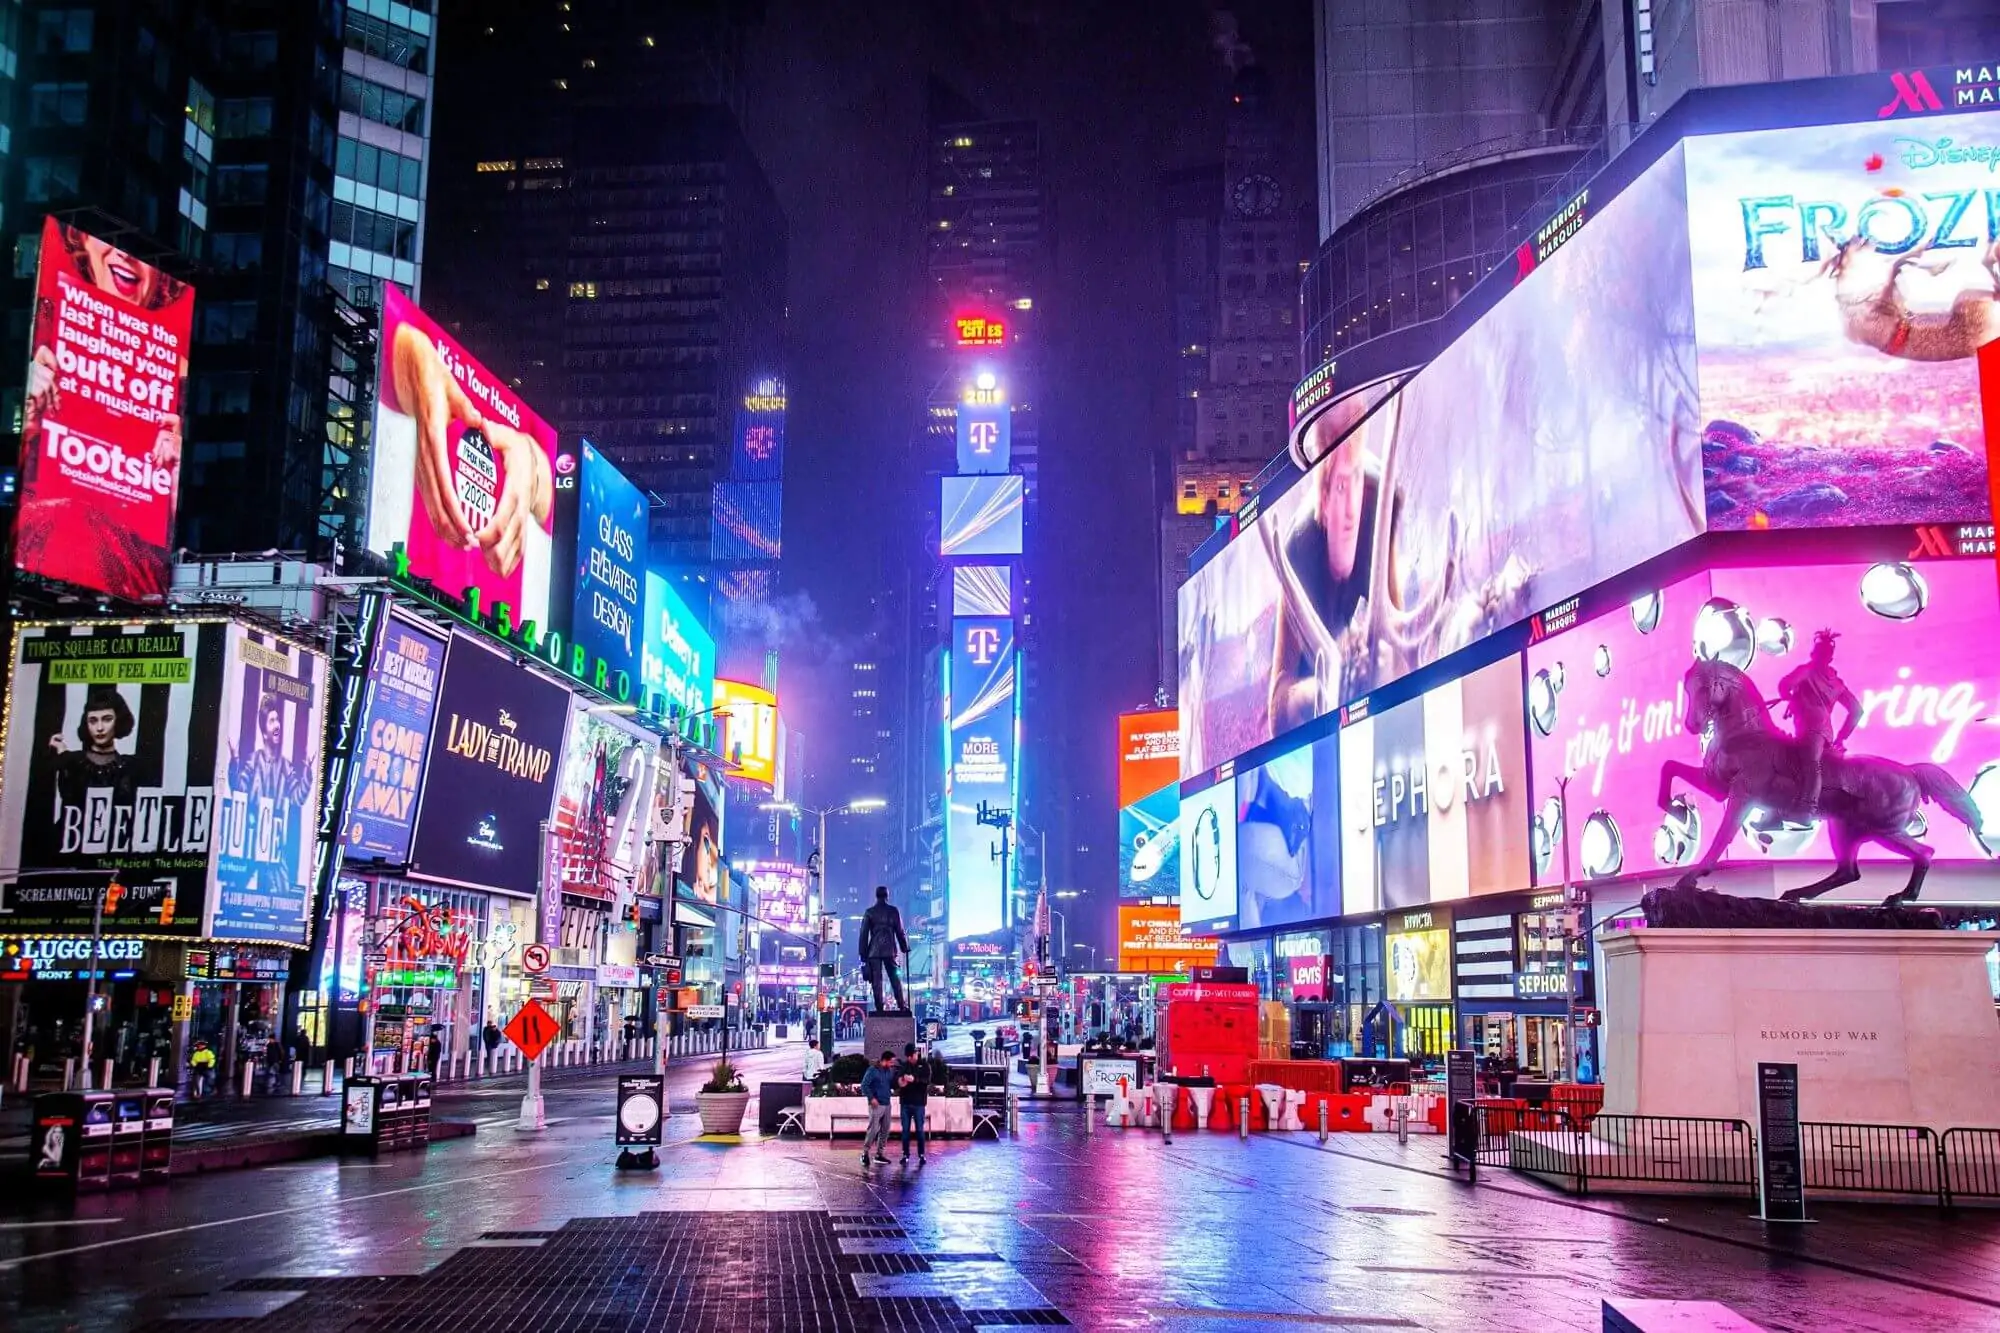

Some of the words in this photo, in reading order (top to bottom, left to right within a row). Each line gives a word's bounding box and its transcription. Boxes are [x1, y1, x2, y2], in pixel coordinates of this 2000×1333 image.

[1956, 65, 2000, 84] MA
[1958, 86, 2000, 105] MA
[1538, 189, 1589, 245] MARRIOTT
[1539, 213, 1583, 261] MARQUIS
[60, 299, 95, 330] last
[100, 319, 141, 349] time
[145, 340, 176, 364] you
[118, 310, 149, 335] was
[152, 323, 178, 347] the
[58, 319, 134, 366] laughed
[136, 356, 175, 382] your
[56, 339, 126, 393] butt
[129, 378, 174, 412] off
[60, 377, 78, 394] at
[81, 385, 92, 399] a
[437, 339, 454, 371] It's
[454, 354, 465, 381] in
[466, 364, 491, 402] Your
[490, 386, 520, 429] Hands
[1296, 361, 1337, 402] MARRIOTT
[1297, 381, 1331, 417] MARQUIS
[41, 418, 172, 495] Tootsie
[465, 450, 478, 464] FOX
[478, 460, 494, 479] NEWS
[465, 481, 487, 512] 2020
[555, 477, 574, 489] LG
[599, 514, 633, 562] GLASS
[590, 547, 638, 605] ELEVATES
[200, 591, 244, 602] LAMAR
[1545, 597, 1580, 622] MARRIOTT
[464, 586, 562, 665] 1540
[1546, 612, 1577, 634] MARQUIS
[27, 641, 61, 657] TIMES
[64, 638, 108, 658] SQUARE
[111, 636, 134, 654] CAN
[137, 635, 181, 654] REALLY
[54, 663, 88, 679] MAKE
[92, 663, 114, 679] YOU
[117, 663, 147, 678] FEEL
[150, 661, 189, 678] ALIVE!
[1859, 667, 1985, 764] ring
[370, 717, 426, 762] COME
[446, 713, 493, 763] LADY
[497, 733, 551, 784] TRAMP
[963, 743, 999, 754] MORE
[1564, 714, 1614, 798] ring
[1617, 697, 1642, 754] it
[1643, 679, 1685, 743] on!
[357, 781, 415, 821] AWAY
[1355, 742, 1505, 833] EPHORA
[59, 796, 208, 854] BEETLE
[546, 850, 559, 929] FROZEN
[1404, 912, 1433, 929] INVICTA
[23, 940, 144, 960] LUGGAGE
[1135, 935, 1172, 943] FLAT-BED
[36, 970, 73, 980] SONY
[1520, 974, 1577, 993] SEPHOR
[176, 996, 185, 1017] ATM
[1761, 1030, 1818, 1041] RUMORS
[1823, 1030, 1841, 1040] OF
[1847, 1030, 1880, 1041] WAR
